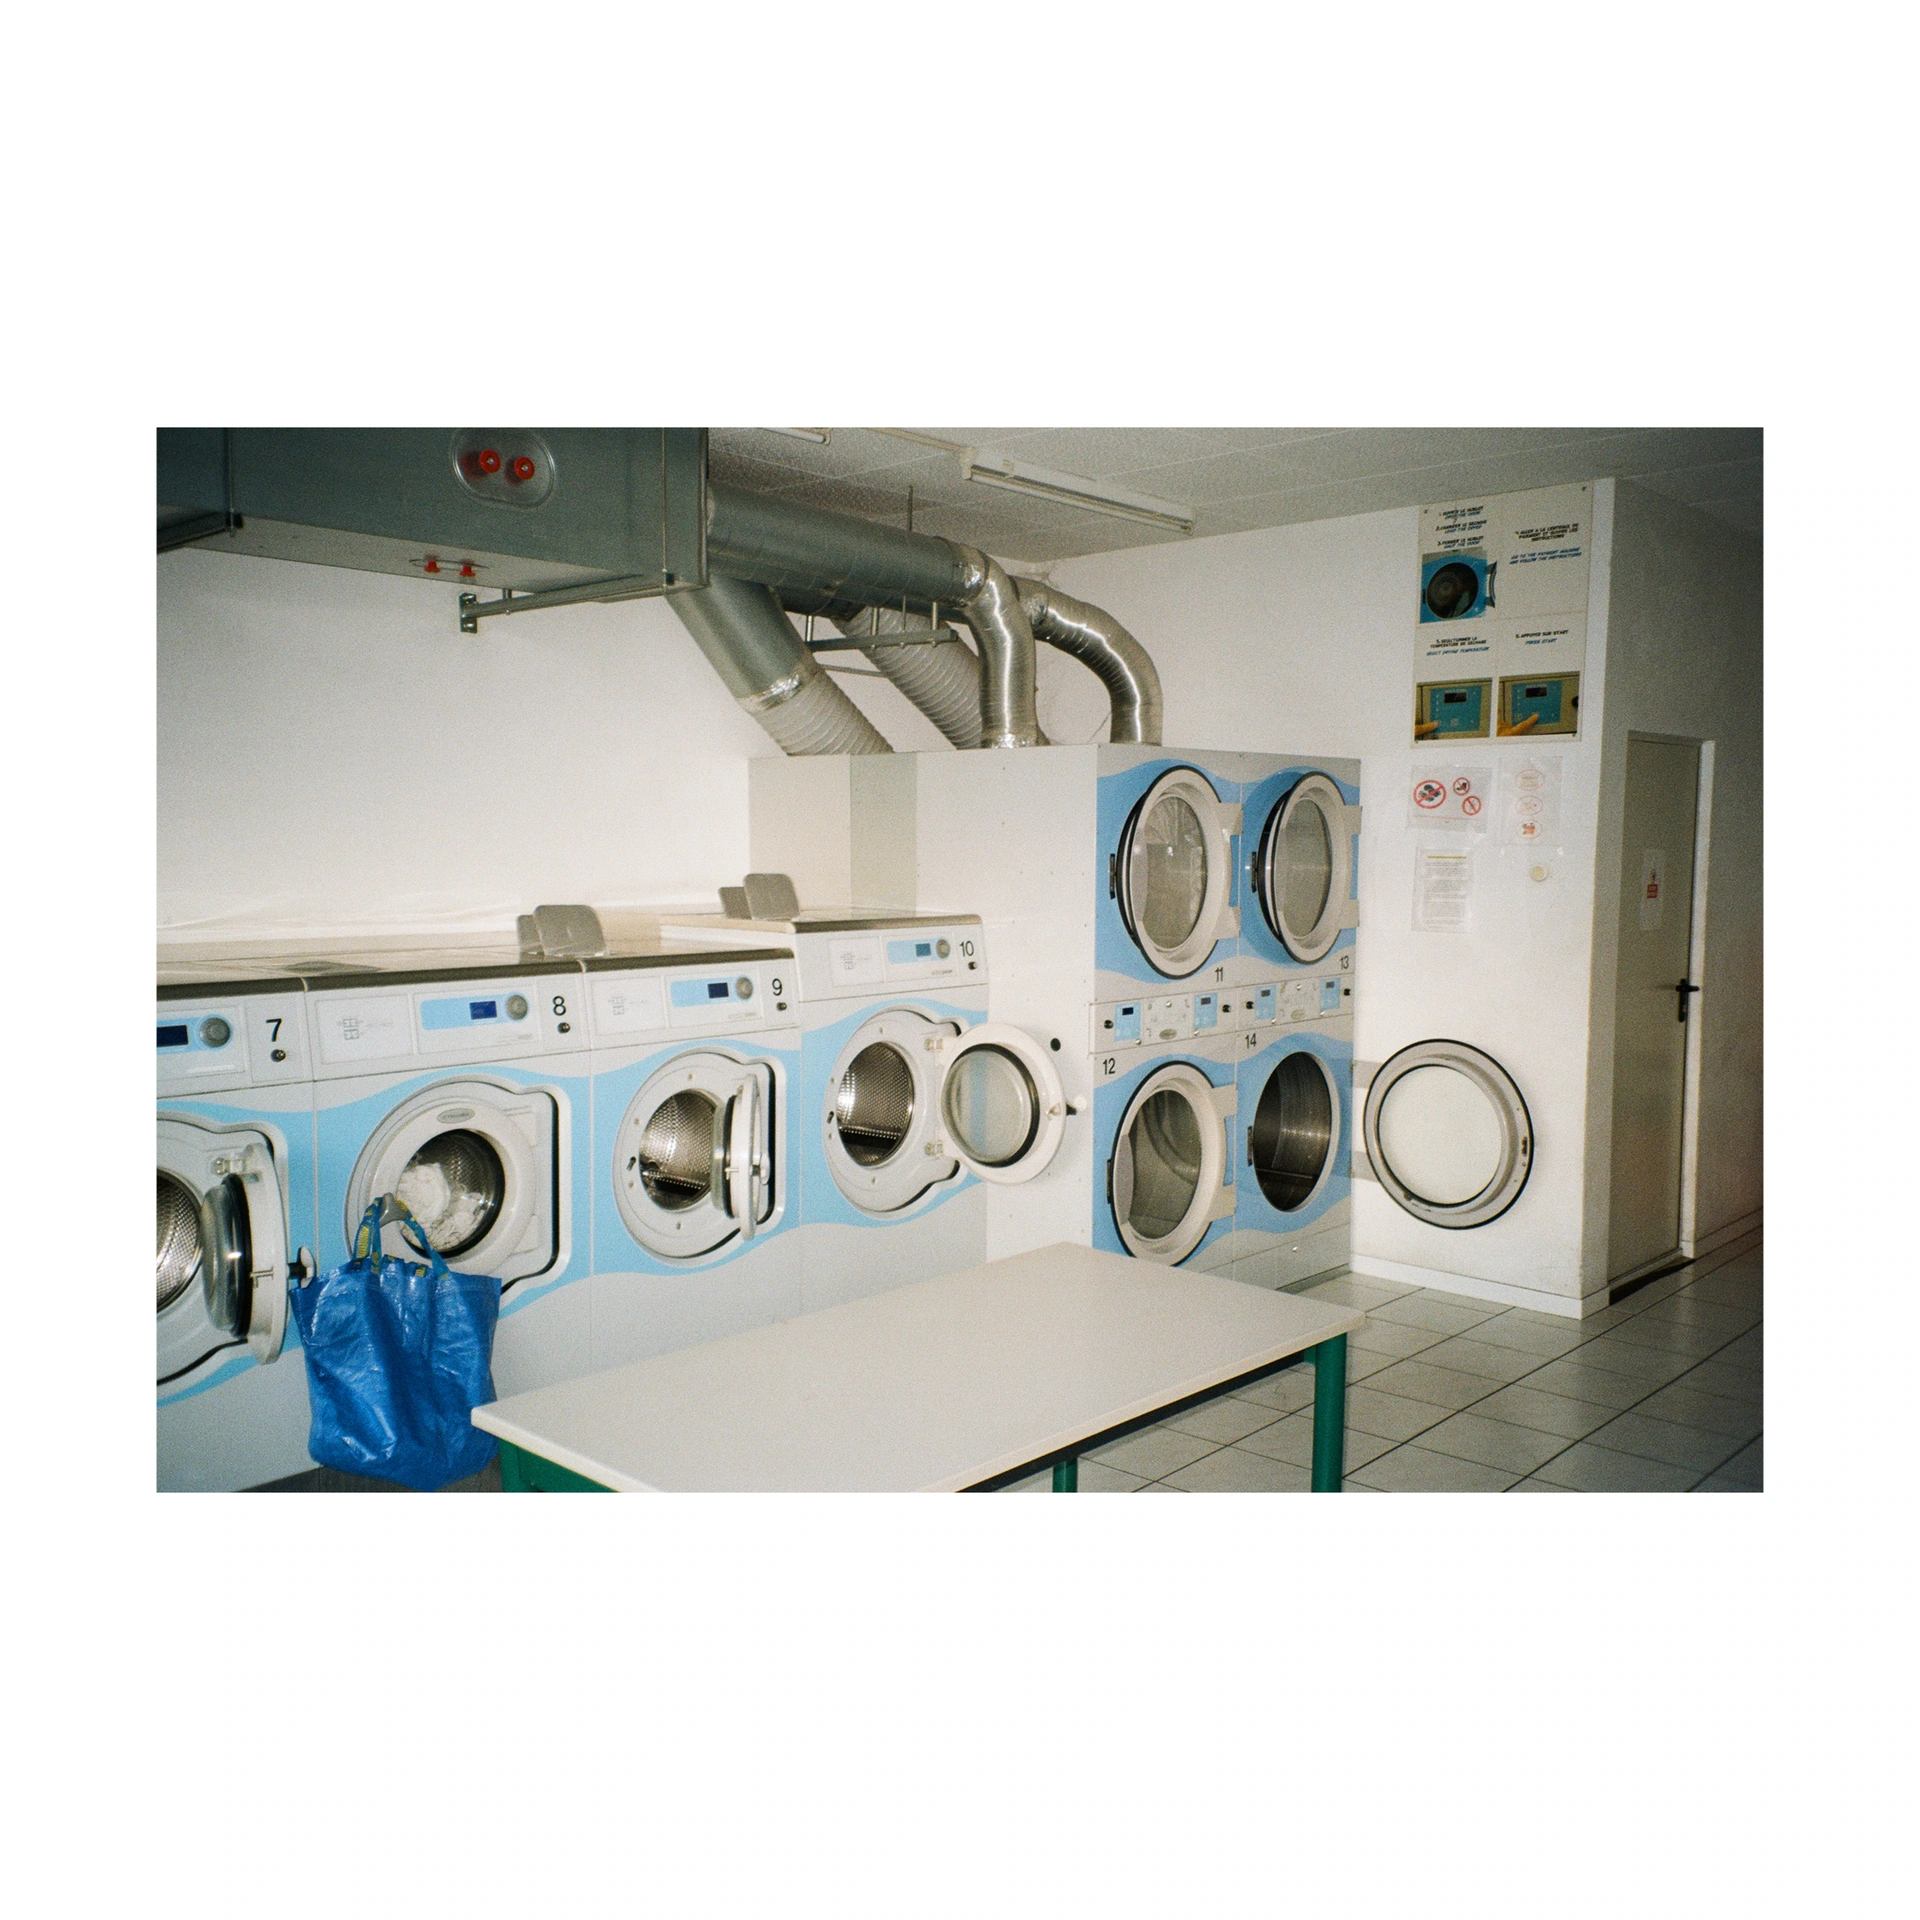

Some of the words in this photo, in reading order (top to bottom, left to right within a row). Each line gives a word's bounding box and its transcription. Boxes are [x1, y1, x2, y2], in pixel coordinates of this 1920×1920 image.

[959, 940, 974, 957] 10
[1340, 955, 1349, 970] 13
[1214, 967, 1223, 982] 11
[771, 978, 783, 997] 9
[553, 995, 566, 1016] 8
[266, 1018, 282, 1042] 7
[1245, 1033, 1257, 1048] 14
[1102, 1058, 1116, 1076] 12
